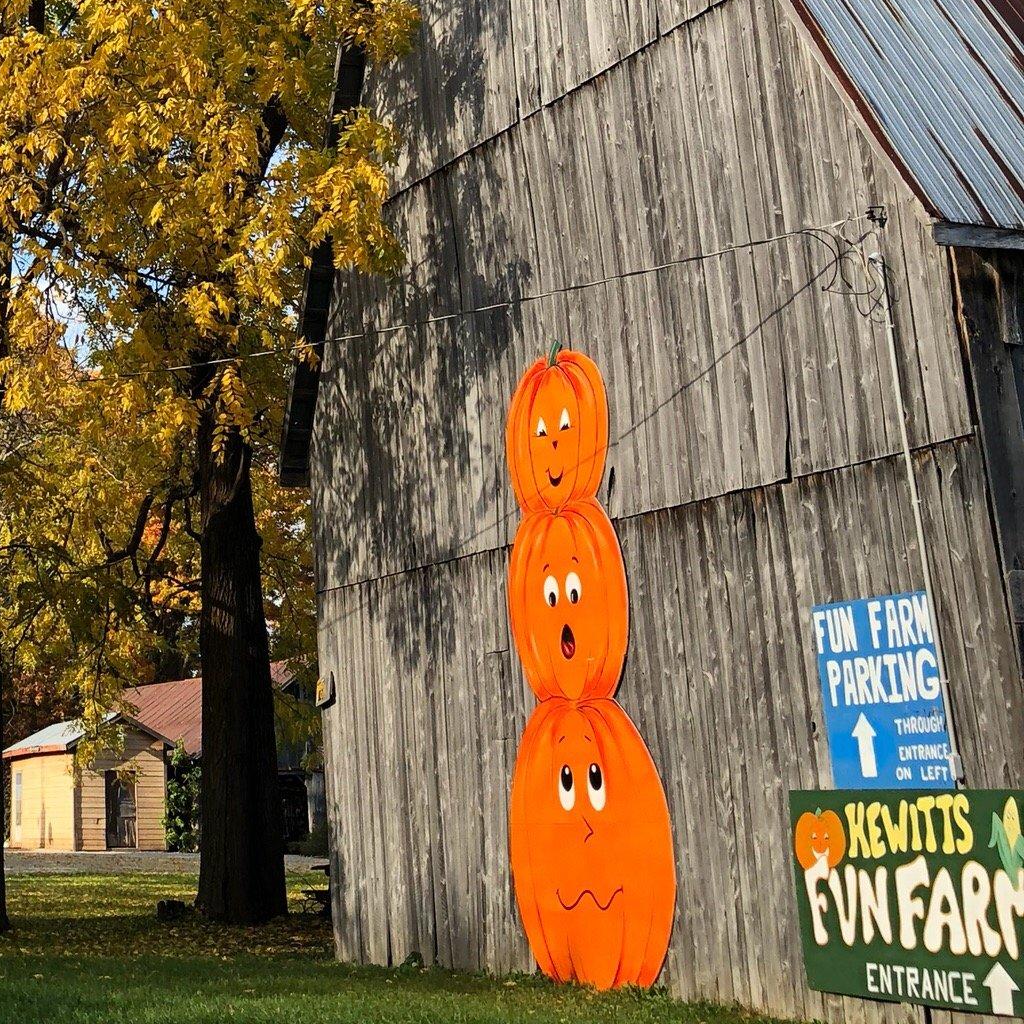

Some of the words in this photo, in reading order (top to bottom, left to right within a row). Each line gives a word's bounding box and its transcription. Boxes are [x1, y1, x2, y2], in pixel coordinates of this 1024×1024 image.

[813, 606, 858, 654] FUN
[867, 595, 933, 649] FARM
[826, 648, 940, 707] PARKING
[894, 716, 944, 735] THROUGH
[896, 766, 912, 781] ON
[920, 765, 948, 781] LEFT
[898, 743, 949, 761] ENTRANCE
[804, 854, 893, 947] FUN
[865, 962, 978, 1006] ENTRANCE
